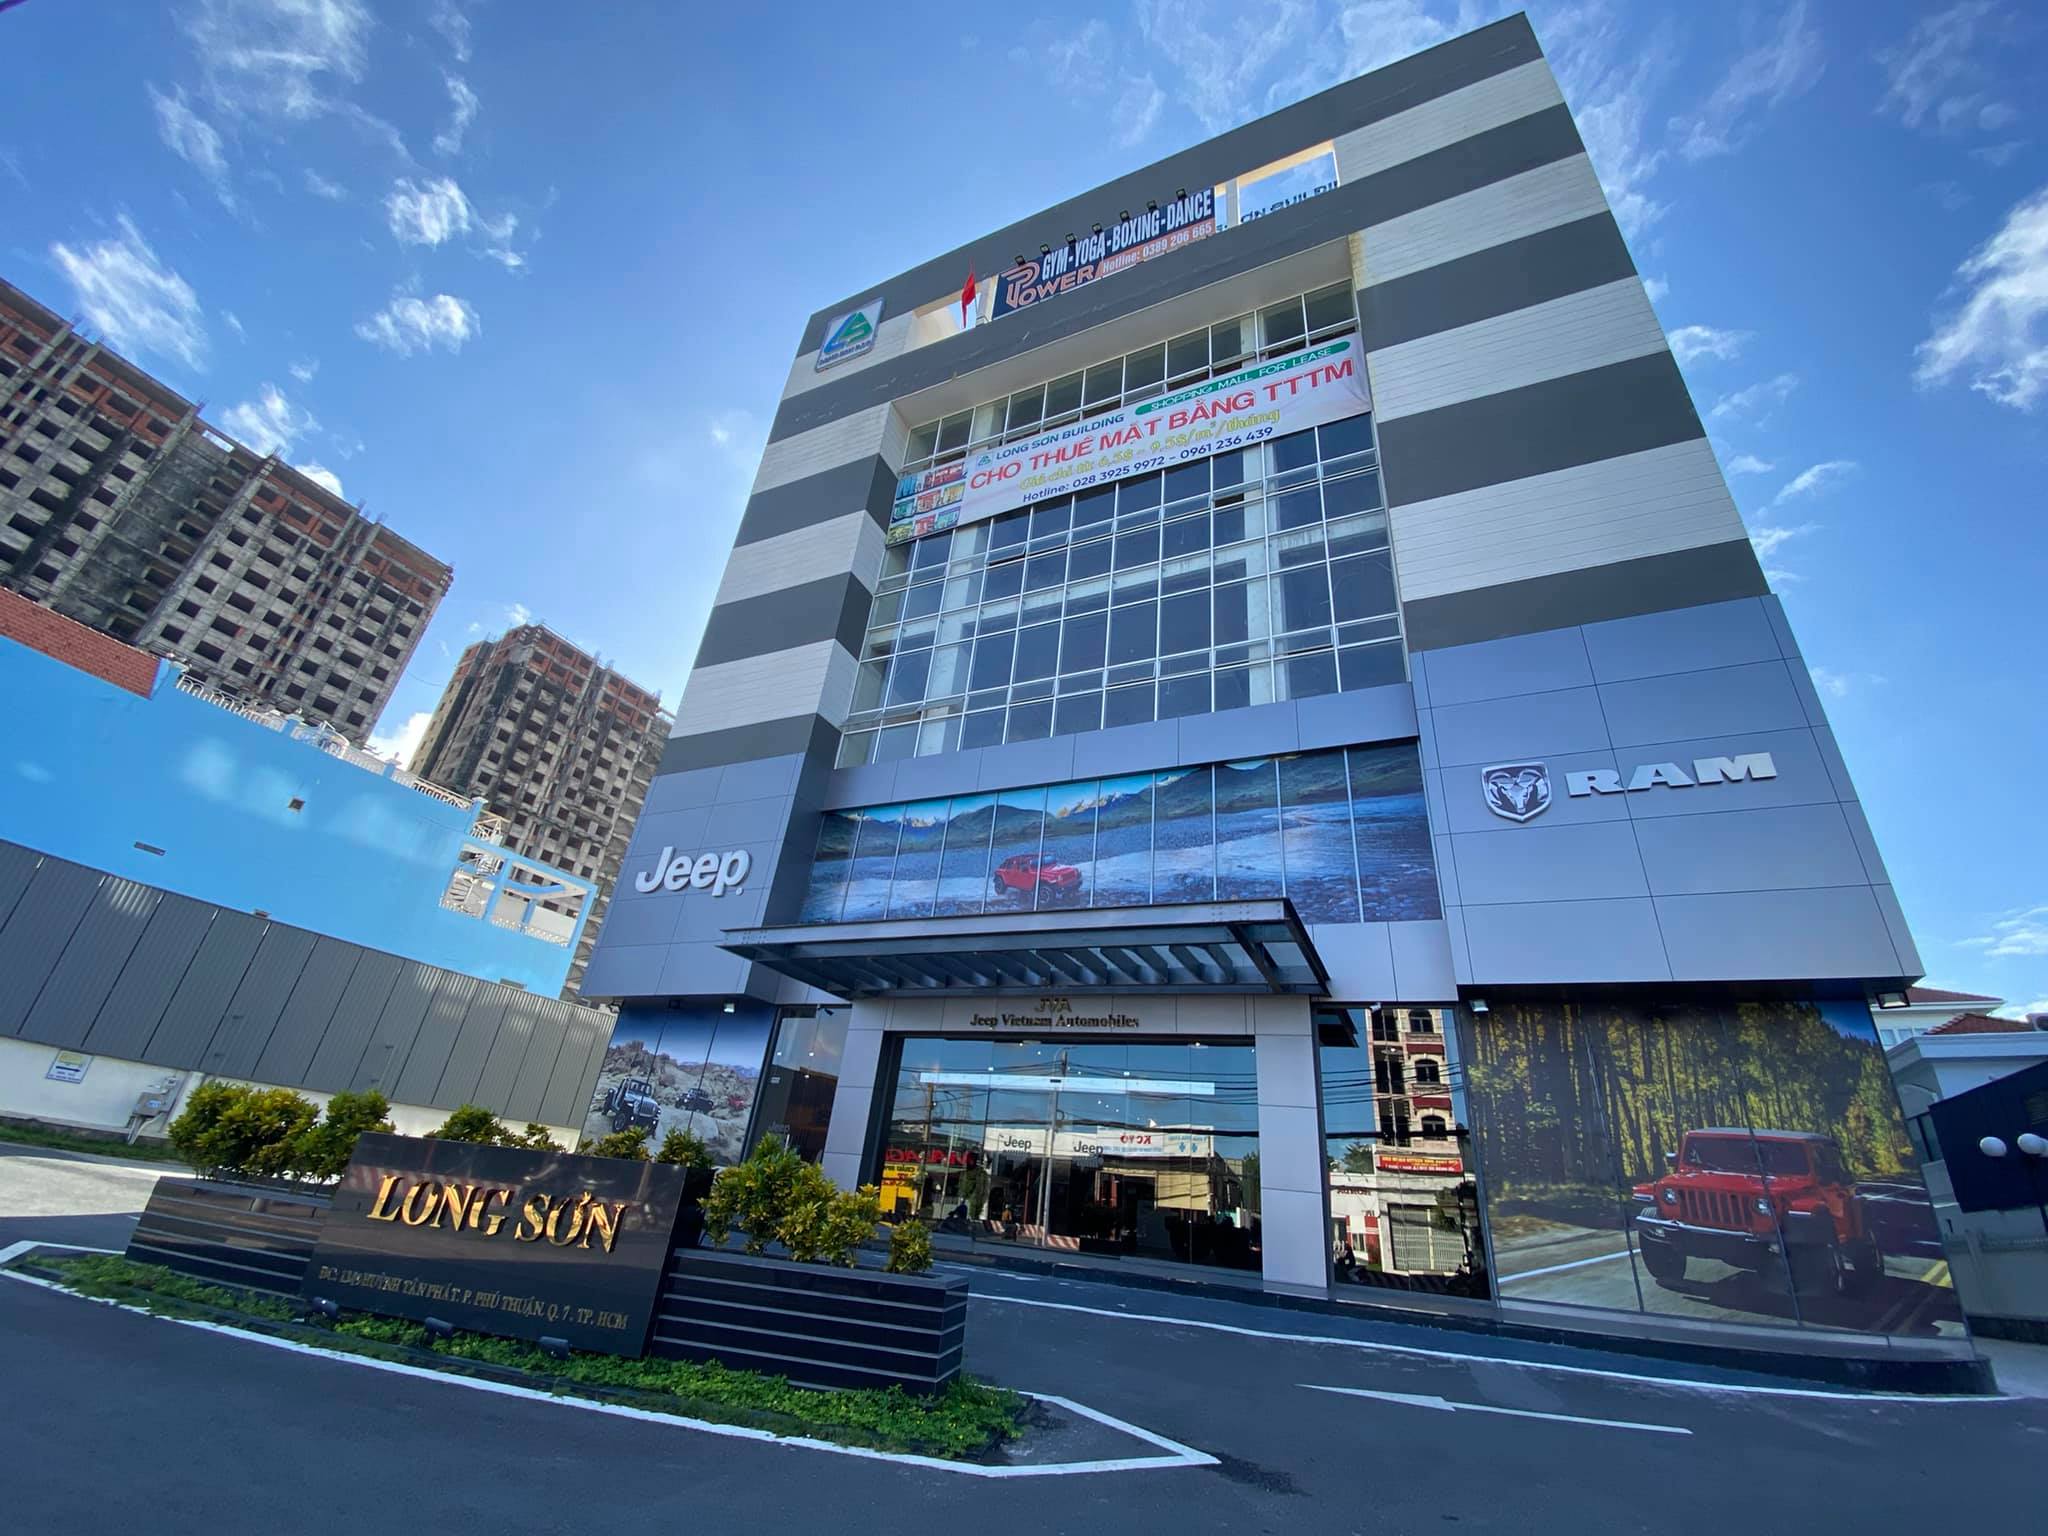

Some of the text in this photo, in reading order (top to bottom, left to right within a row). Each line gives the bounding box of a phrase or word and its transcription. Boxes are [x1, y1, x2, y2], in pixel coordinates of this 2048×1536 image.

[1103, 251, 1140, 273] Hotline:
[1150, 347, 1333, 411] SHOPPING MALL FOR LEASE
[969, 460, 1023, 490] CHO
[1029, 437, 1094, 472] THUÊ
[1262, 358, 1354, 402] TTTM
[996, 442, 1029, 461] LONG
[1062, 413, 1125, 439] BUILDING
[1023, 483, 1070, 502] Hotline:
[1072, 475, 1097, 488] 028
[1100, 465, 1130, 481] 3925
[1133, 455, 1165, 470] 9972
[1180, 443, 1212, 459] 0961
[1215, 436, 1242, 450] 236
[1246, 426, 1274, 441] 439
[1565, 752, 1778, 797] RAM
[635, 846, 752, 898] Jeep
[970, 1013, 1140, 1029] Jeep Vietnam Automobiles
[1003, 1135, 1032, 1151] Jeep
[1073, 1140, 1104, 1156] Jeep
[365, 1174, 627, 1253] LONG SƠN
[597, 1311, 629, 1330] HCM
